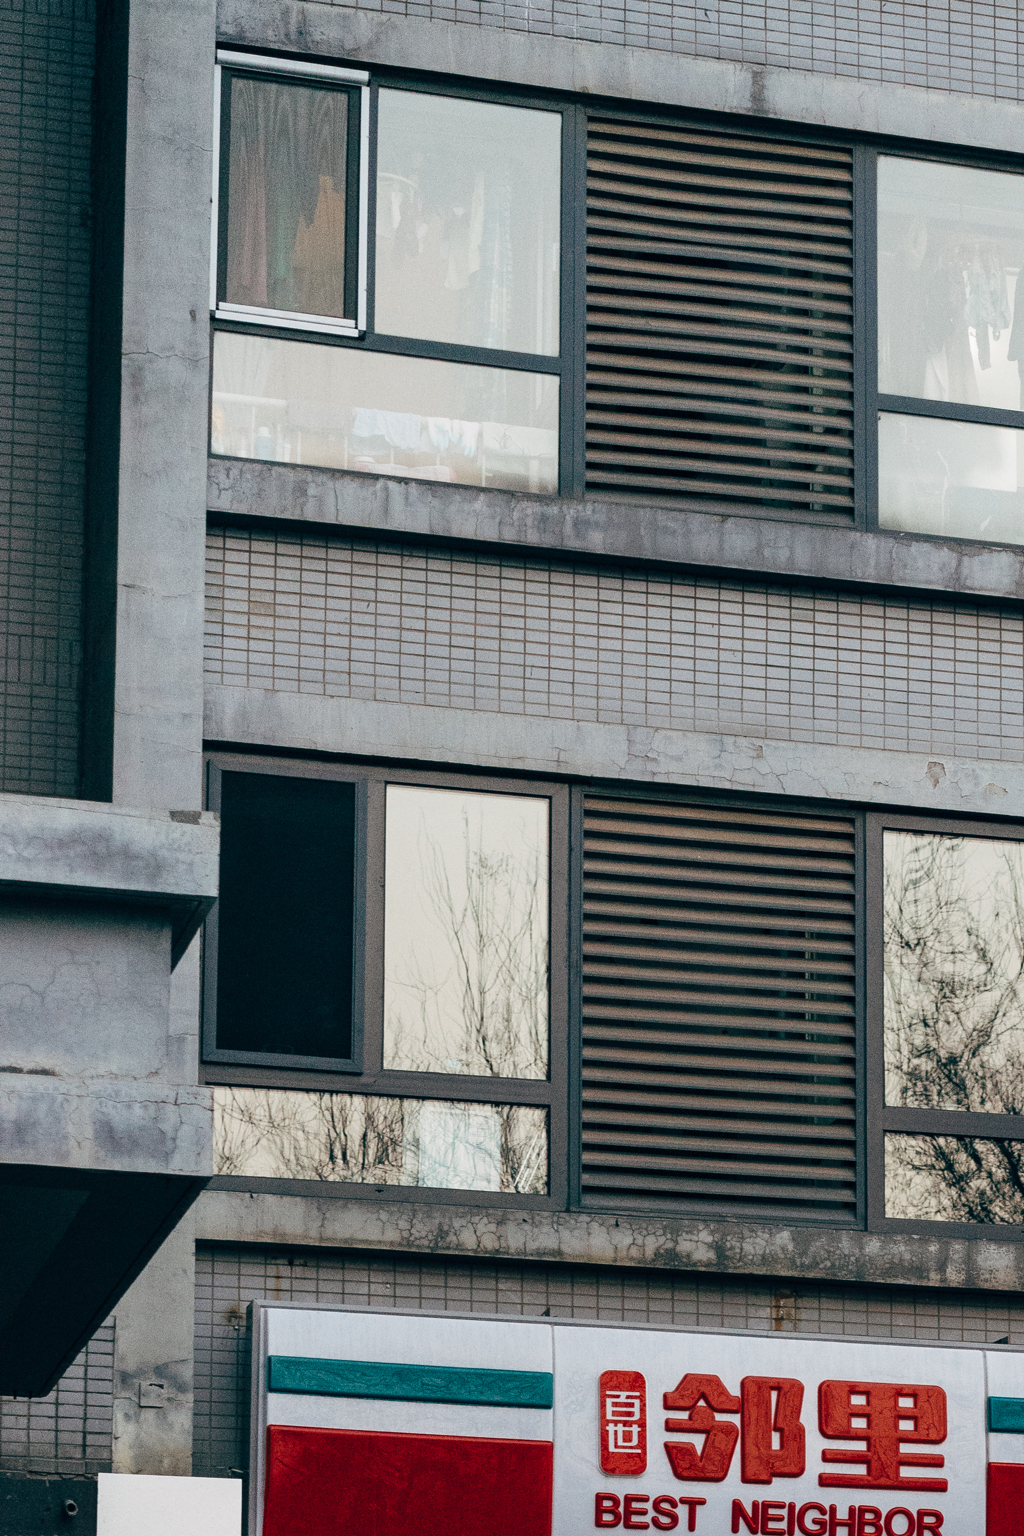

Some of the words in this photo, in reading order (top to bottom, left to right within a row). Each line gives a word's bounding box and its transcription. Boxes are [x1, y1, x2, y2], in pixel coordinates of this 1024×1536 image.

[604, 1389, 642, 1454] 百世
[663, 1372, 949, 1492] 邻里
[594, 1492, 707, 1532] BEST
